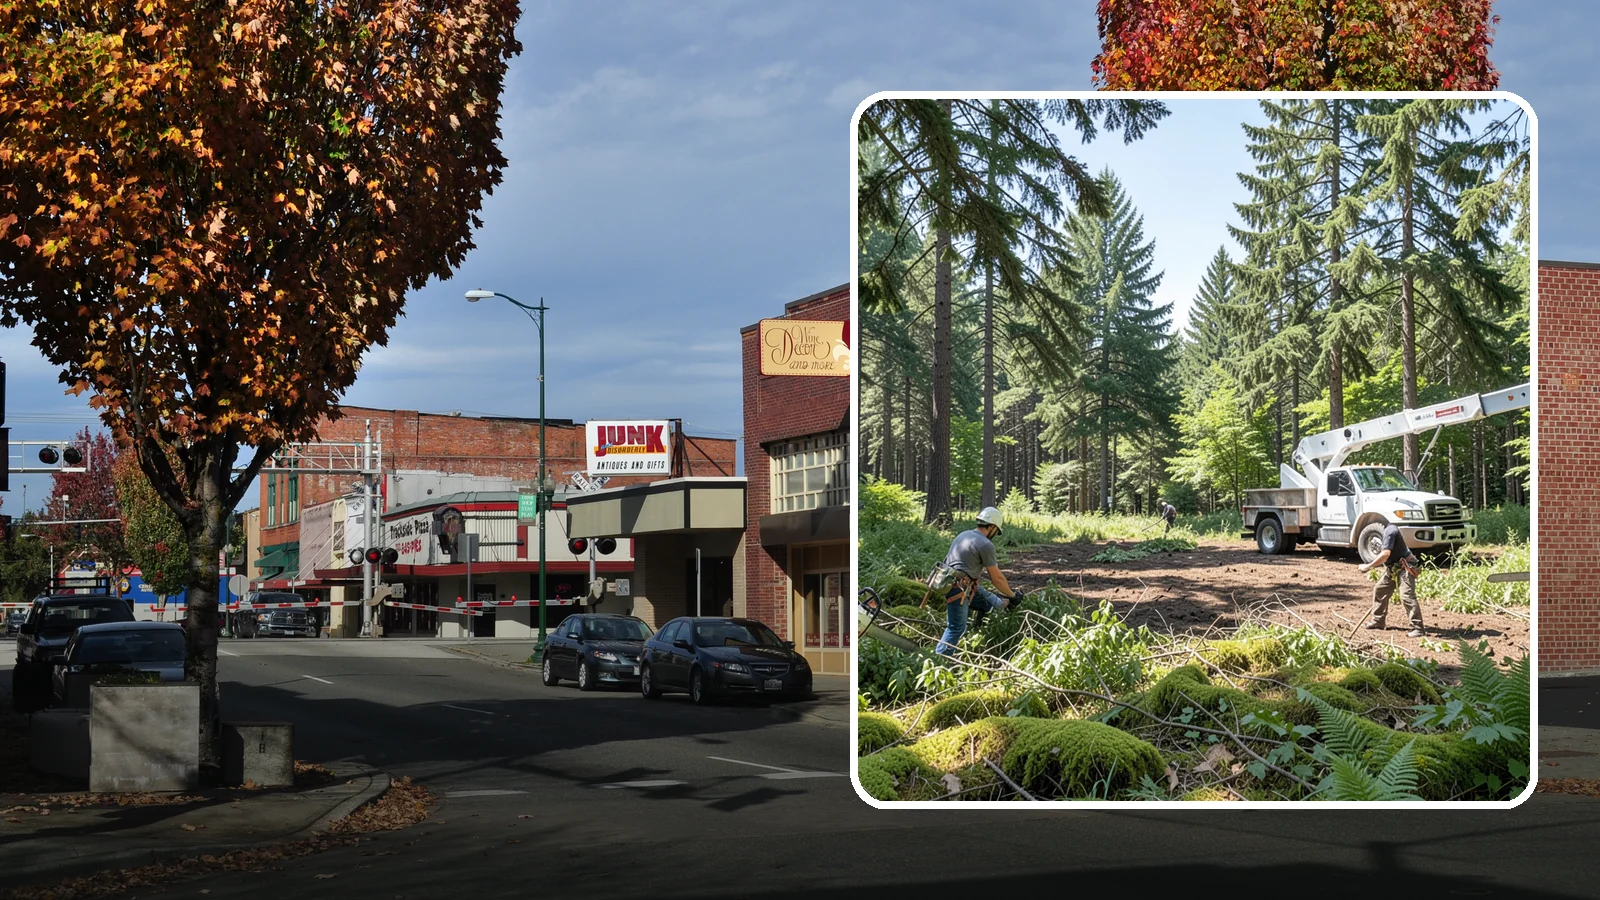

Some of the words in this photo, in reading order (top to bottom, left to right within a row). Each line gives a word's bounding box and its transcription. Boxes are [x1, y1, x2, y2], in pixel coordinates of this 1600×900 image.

[765, 328, 831, 365] Decor
[595, 425, 666, 457] JUNK
[607, 446, 646, 454] DISORDERLY
[596, 461, 628, 470] ANTIQUES
[631, 461, 644, 470] AND
[647, 460, 666, 469] GIFTS
[573, 473, 589, 492] RAIL
[390, 520, 413, 539] Trackside
[414, 519, 429, 534] Pizza
